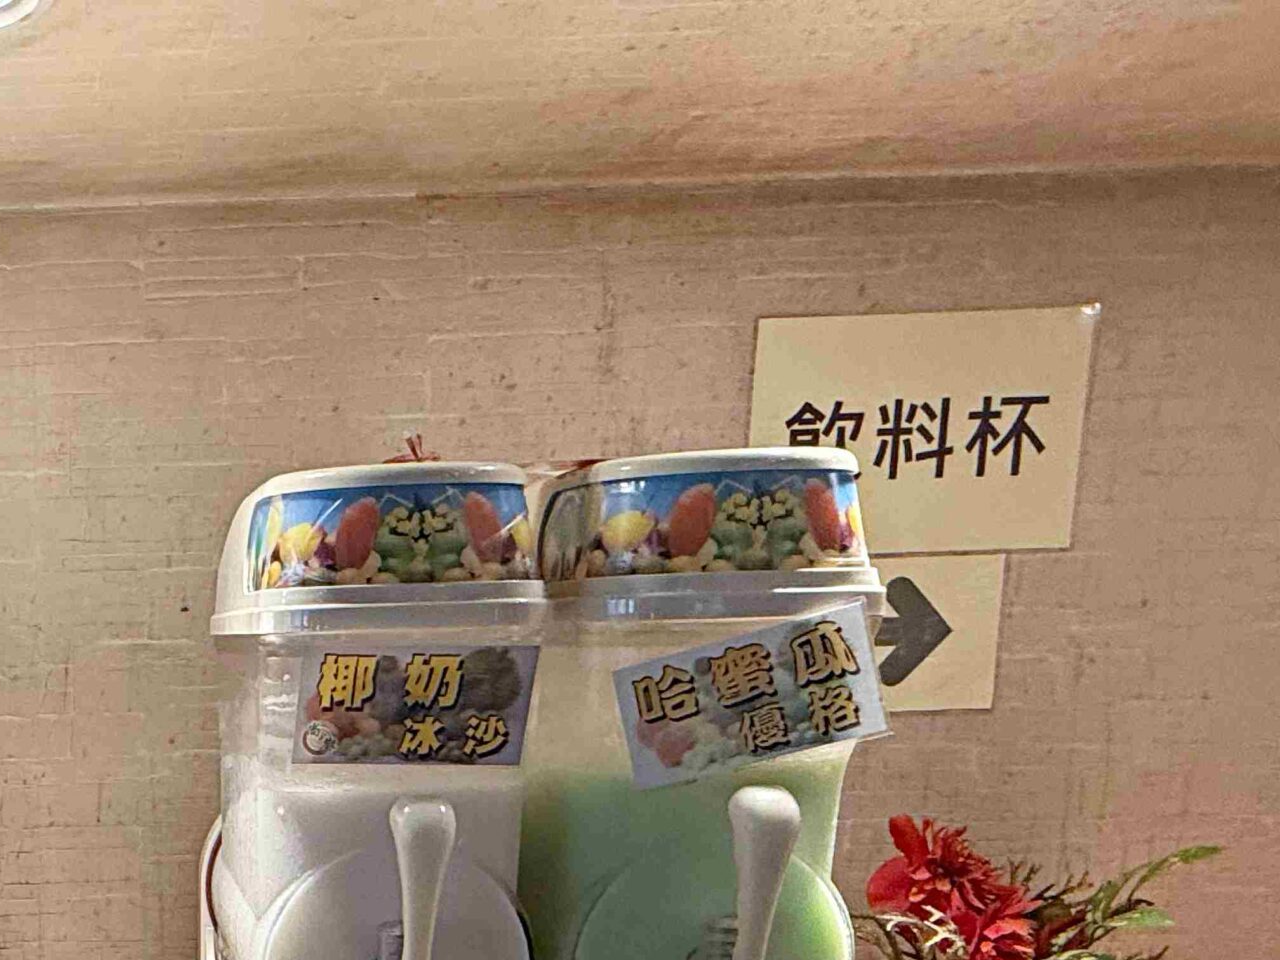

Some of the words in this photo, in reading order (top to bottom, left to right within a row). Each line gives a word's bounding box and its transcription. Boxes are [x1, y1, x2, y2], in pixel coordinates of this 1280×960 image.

[784, 395, 1051, 480] 飲料杯
[316, 653, 465, 712] 椰奶
[632, 620, 861, 724] 哈蜜瓜
[398, 713, 510, 759] 冰沙
[739, 684, 861, 753] 優格
